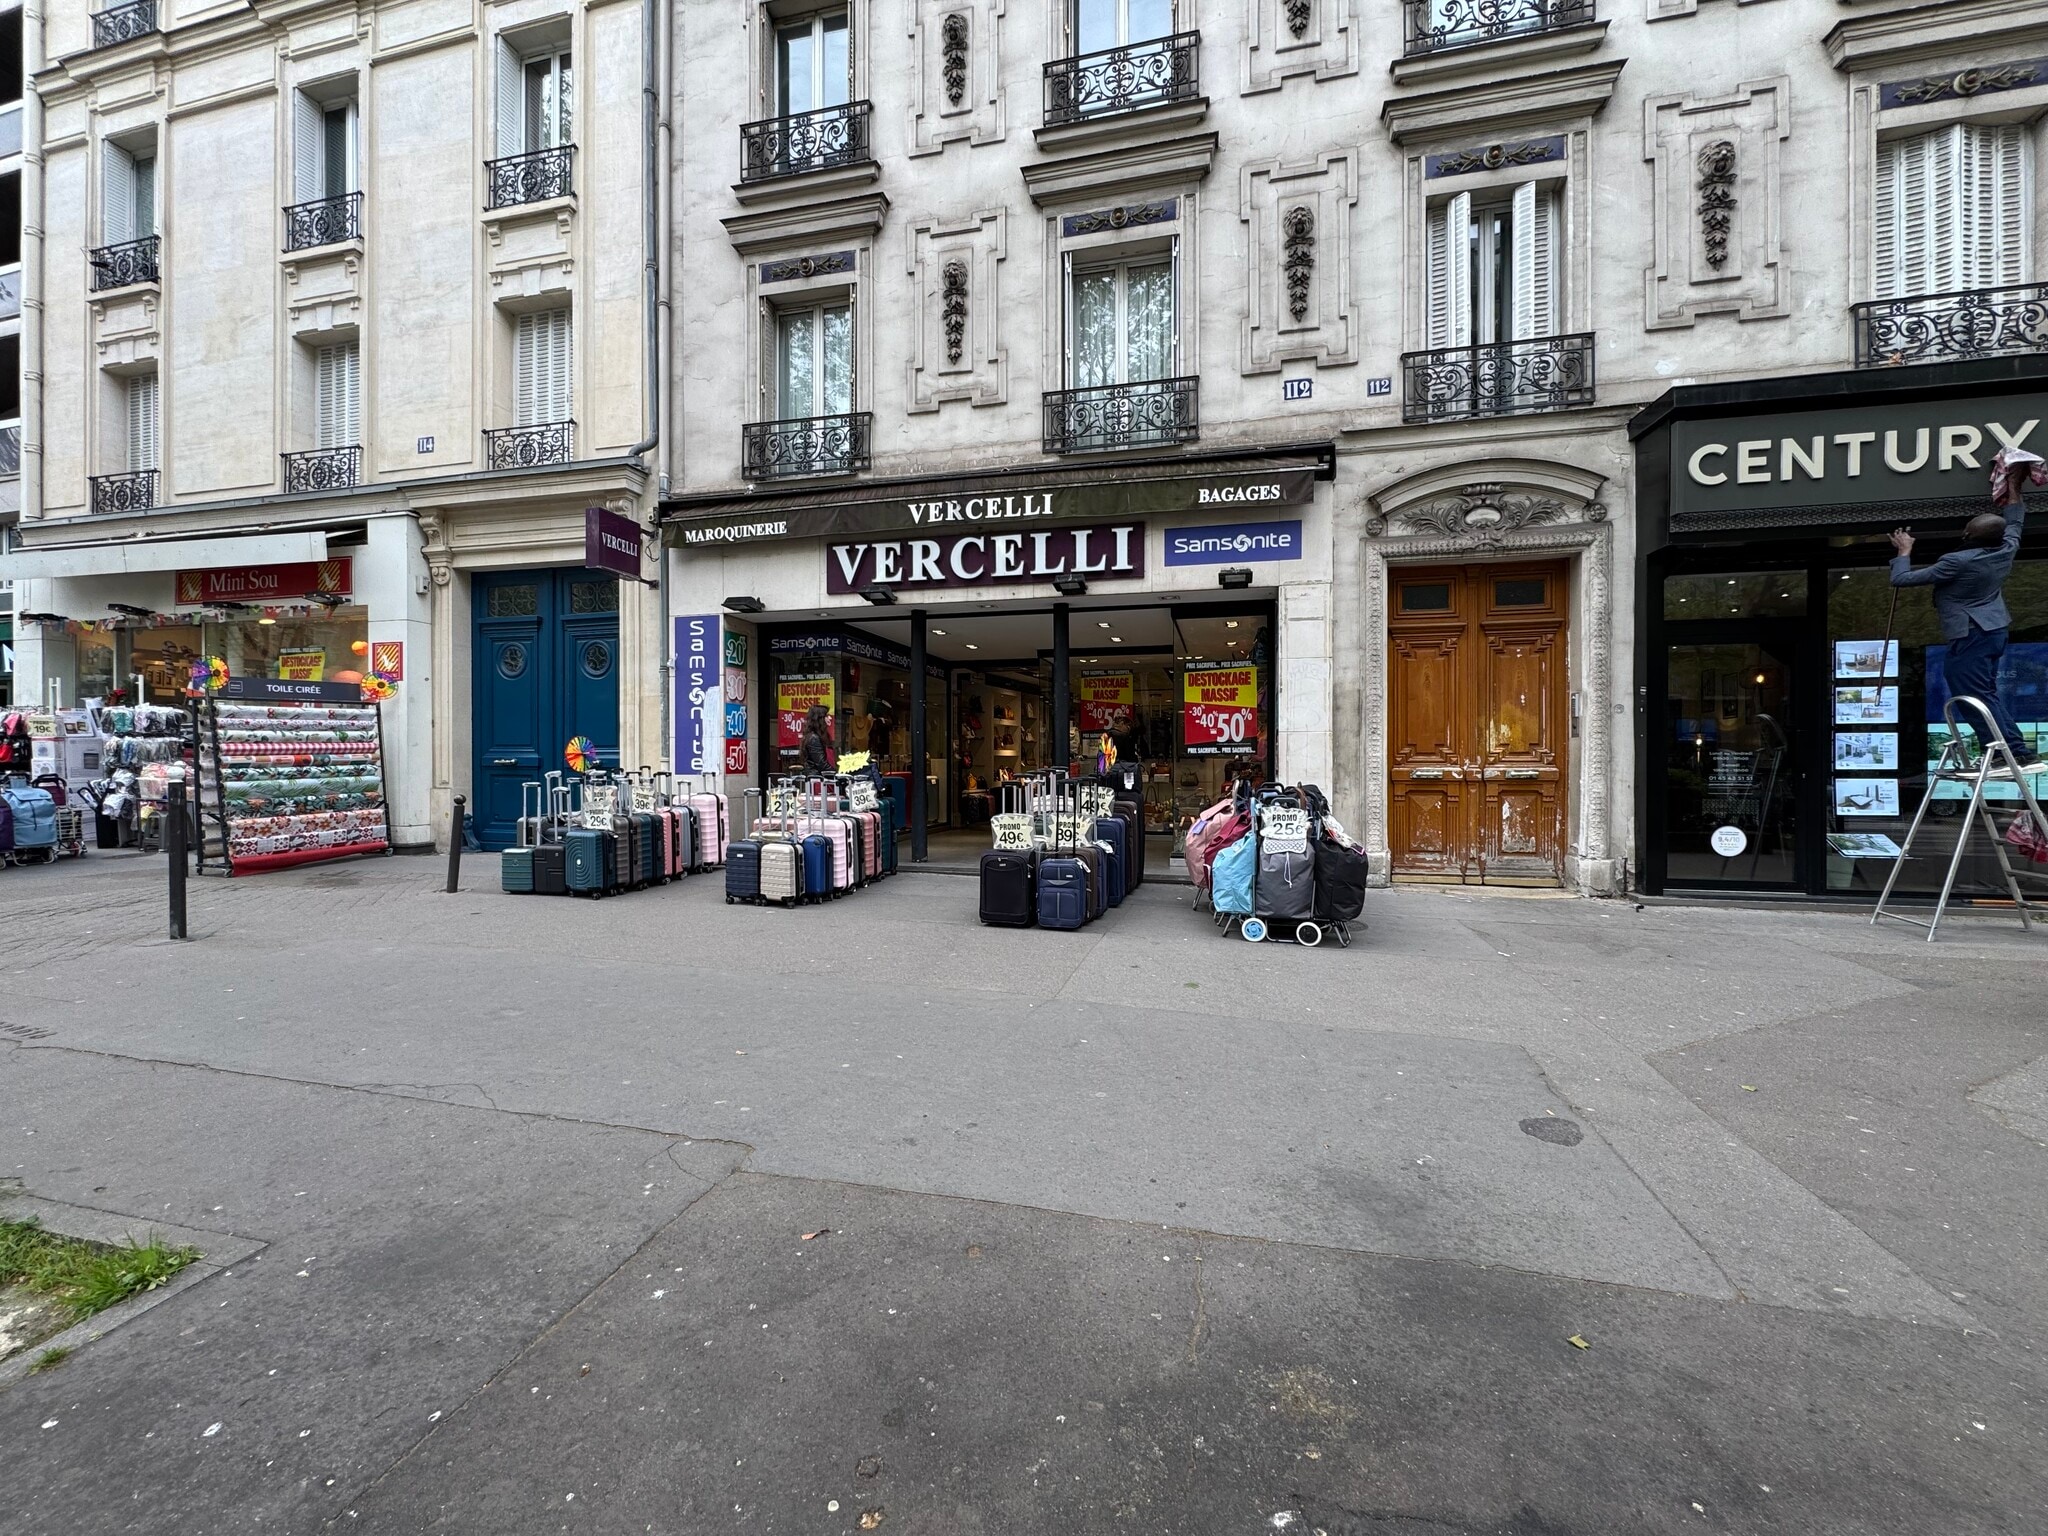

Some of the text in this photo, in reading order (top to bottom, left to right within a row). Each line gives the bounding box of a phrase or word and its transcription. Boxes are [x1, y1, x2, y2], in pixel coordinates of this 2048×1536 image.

[1286, 381, 1310, 399] 112
[1370, 380, 1390, 394] 112
[420, 438, 433, 451] 114
[1688, 419, 2040, 486] CENTURY
[1198, 484, 1280, 504] BAGAGES
[908, 494, 1053, 524] VERCELLI
[685, 521, 787, 543] MAROQUINERIE
[601, 532, 638, 557] VERCELLI
[1174, 533, 1291, 553] Samsonite
[832, 527, 1133, 585] VERCELLI
[210, 570, 278, 593] Mini Sou
[771, 637, 839, 649] Samsonite
[1083, 677, 1129, 689] DESTOCKAGE
[1188, 671, 1251, 687] DESTOCKAGE
[267, 684, 322, 694] TOILE CIRÉE
[689, 620, 705, 771] Samsonite
[781, 683, 830, 696] DESTOCKAGE
[1093, 689, 1120, 700] MASSIF
[1201, 688, 1239, 702] MASSIF
[635, 798, 650, 809] 39€
[854, 794, 872, 806] 39€
[590, 815, 607, 826] 29€
[1272, 814, 1297, 822] PROMO
[1273, 822, 1303, 835] 25€
[999, 831, 1024, 844] 49€
